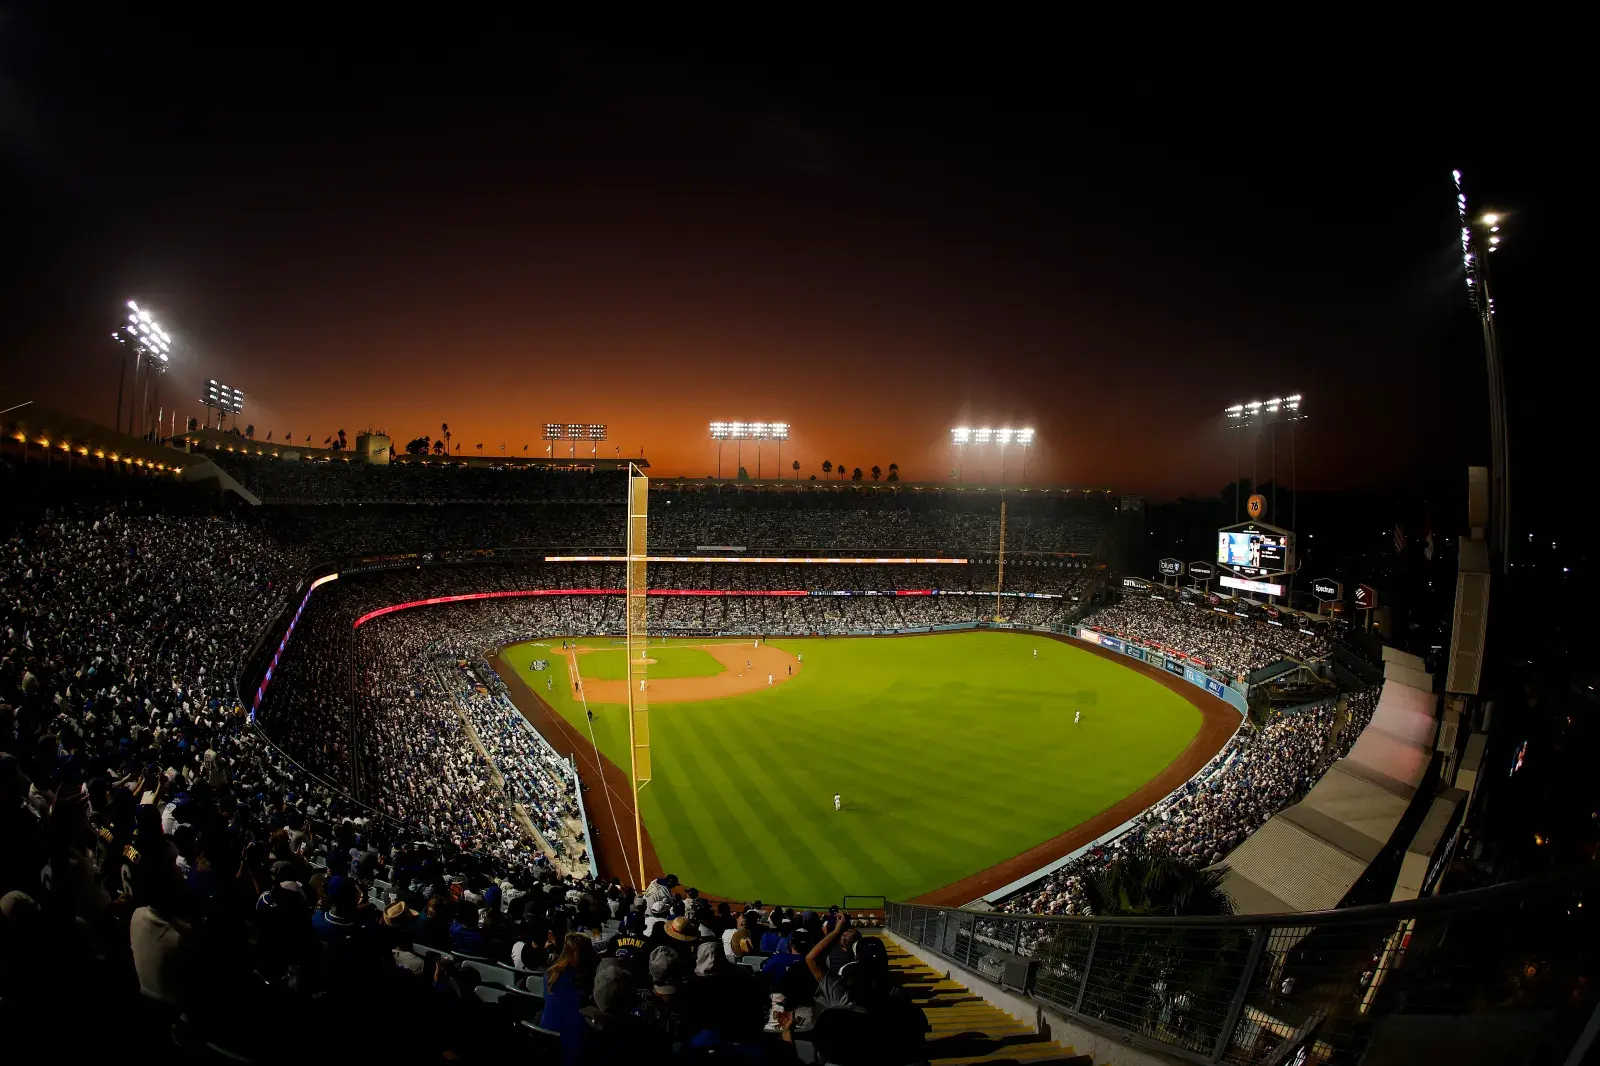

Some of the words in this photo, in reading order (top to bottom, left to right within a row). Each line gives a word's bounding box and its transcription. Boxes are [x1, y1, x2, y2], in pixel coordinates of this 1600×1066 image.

[1250, 501, 1259, 511] 76
[1315, 584, 1335, 595] Spectrum
[617, 937, 645, 949] BRYANT
